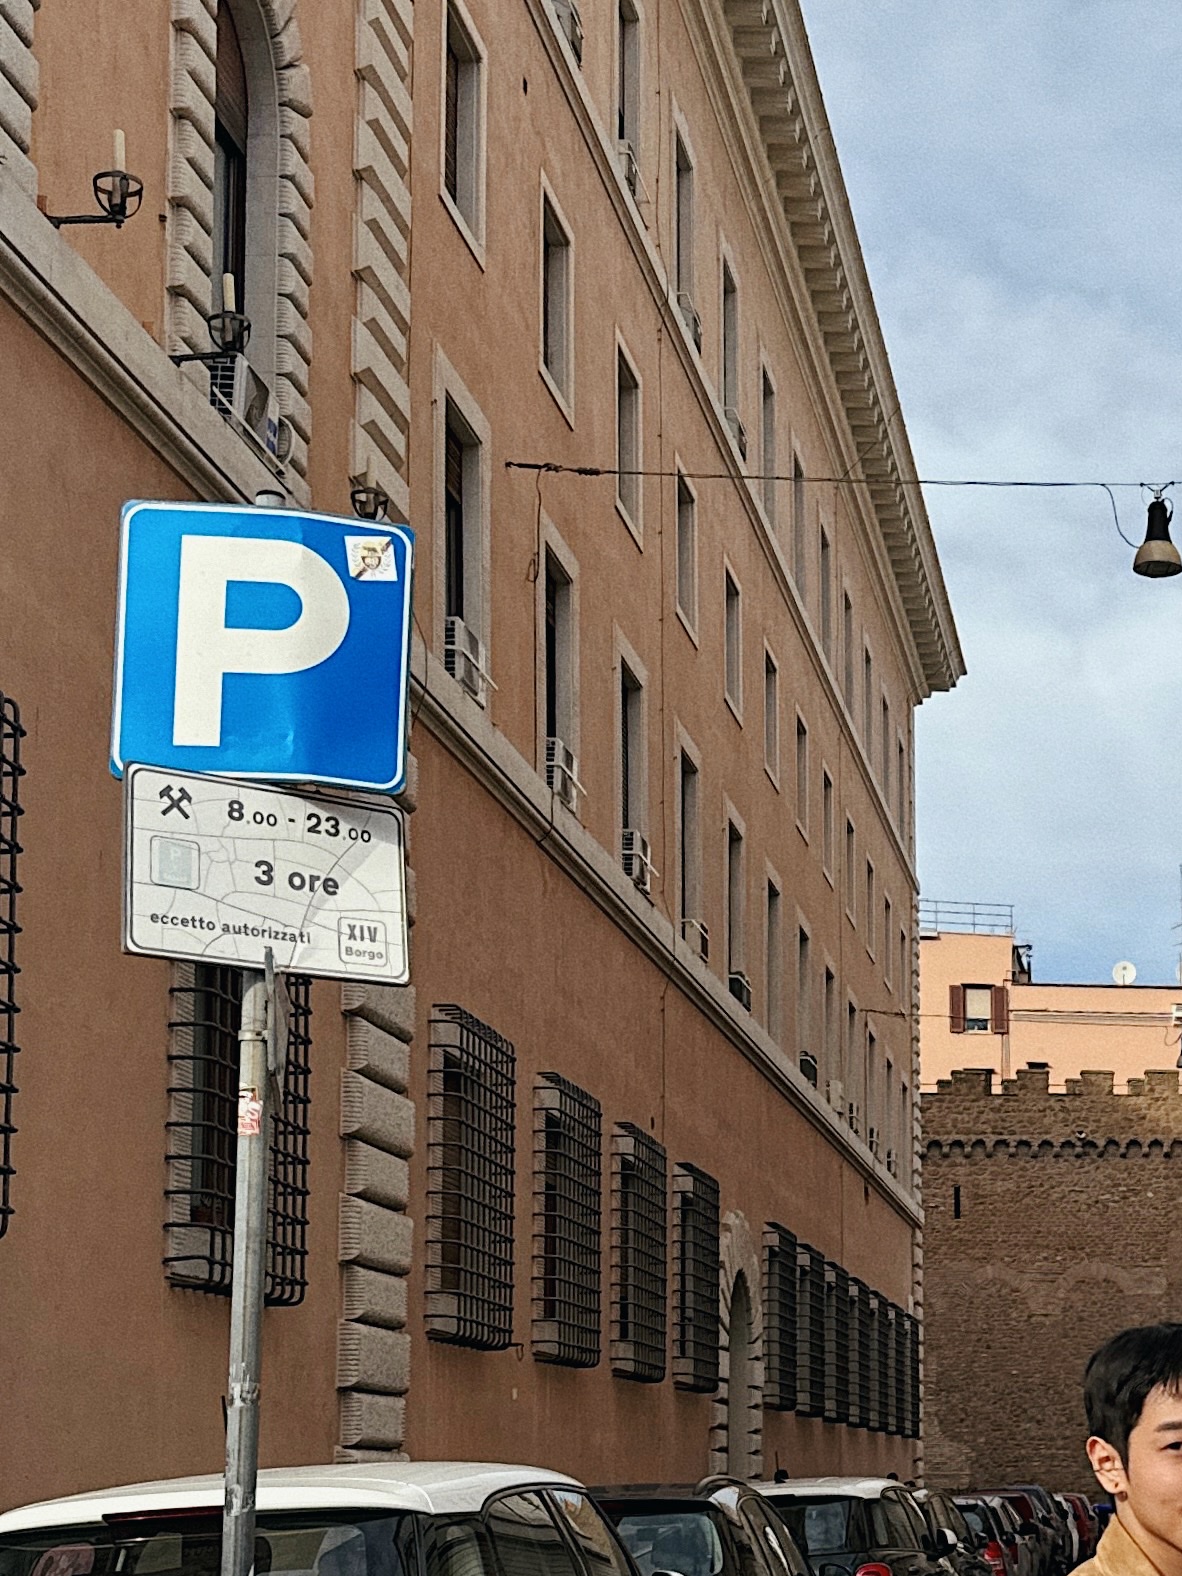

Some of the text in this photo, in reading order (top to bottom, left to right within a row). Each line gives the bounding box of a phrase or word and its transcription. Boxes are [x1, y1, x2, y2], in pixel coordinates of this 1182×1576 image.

[172, 535, 350, 747] P
[227, 799, 278, 828] 8.00
[306, 812, 372, 843] 23.00
[254, 860, 339, 896] 3 ore
[150, 912, 311, 944] eccetto autorizzati
[347, 923, 378, 943] XIV
[345, 946, 384, 961] Borgo
